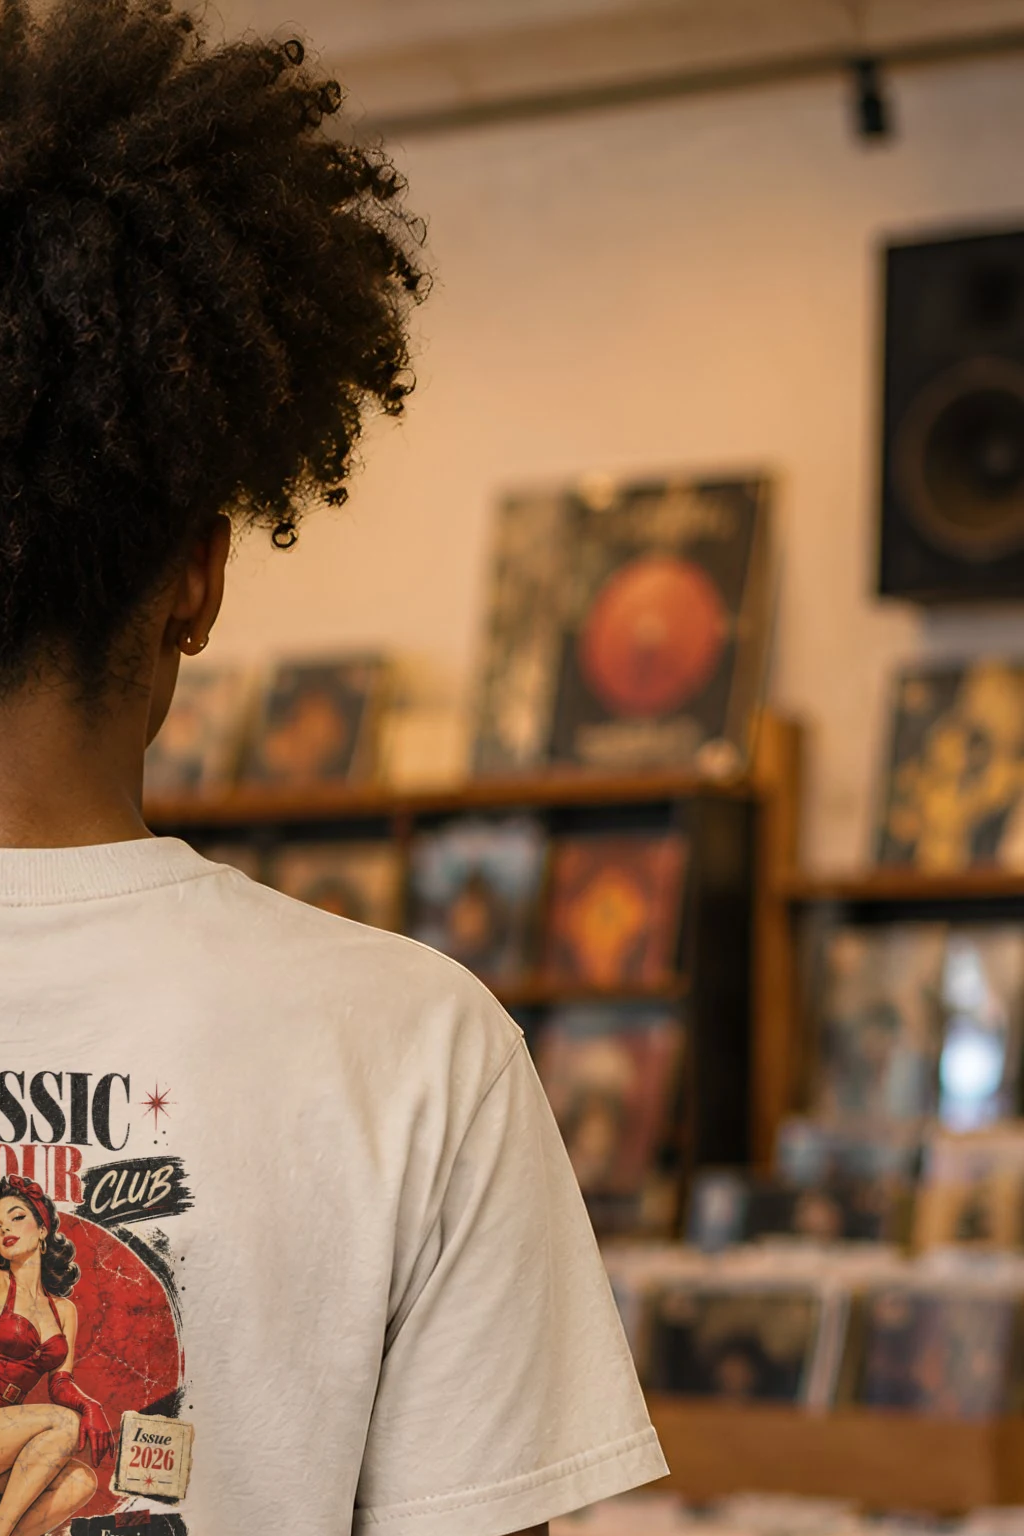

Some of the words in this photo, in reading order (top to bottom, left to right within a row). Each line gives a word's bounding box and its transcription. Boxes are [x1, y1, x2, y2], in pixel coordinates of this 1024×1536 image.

[91, 1165, 174, 1214] CLUB
[132, 1427, 172, 1446] Issue
[129, 1445, 175, 1471] 2026
